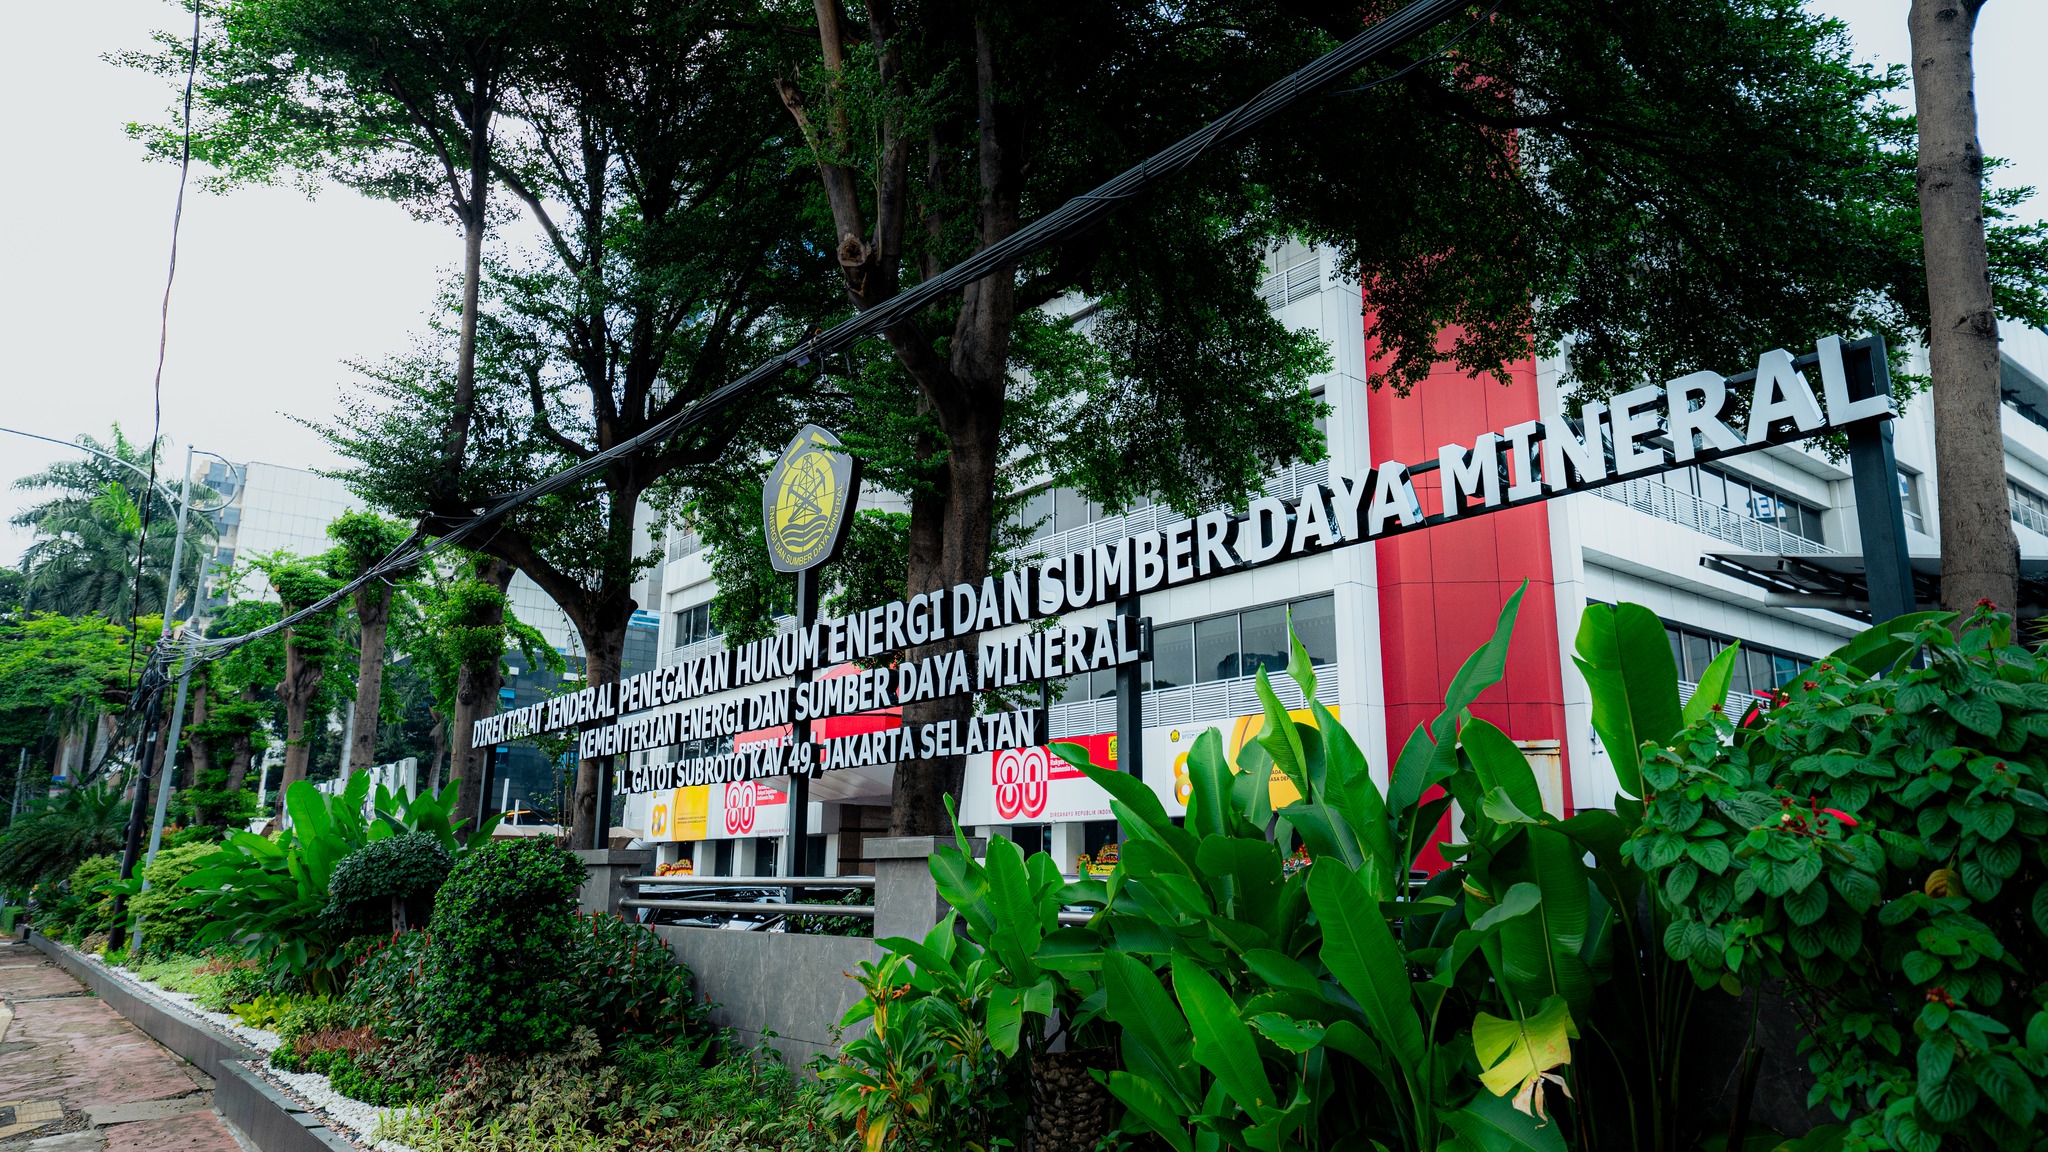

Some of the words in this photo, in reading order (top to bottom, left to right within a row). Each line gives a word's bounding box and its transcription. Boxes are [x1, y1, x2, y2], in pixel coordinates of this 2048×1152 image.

[472, 702, 545, 749] DIREKTORAT
[544, 682, 615, 732] JENDERAL
[619, 651, 729, 711] PENEGAKAN
[735, 624, 820, 685] HUKUM
[830, 588, 945, 664] ENERGI
[952, 566, 1030, 637] DAN
[1038, 509, 1237, 615] SUMBER
[1250, 460, 1424, 564] DAYA
[1439, 335, 1897, 517] MINERAL
[769, 505, 778, 543] ENERGI
[774, 541, 787, 560] DAN
[785, 552, 813, 566] SUMBER
[813, 534, 830, 557] DAYA
[828, 482, 843, 533] MINERAL
[579, 711, 677, 760] KEMENTERIAN
[680, 699, 744, 742] ENERGI
[748, 688, 788, 731] DAN
[795, 667, 891, 721] SUMBER
[898, 650, 970, 704] DAYA
[978, 614, 1139, 691] MINERAL
[614, 769, 631, 796] JL.
[632, 762, 676, 793] GATOT
[676, 751, 746, 788] SUBROTO
[821, 726, 915, 771] JAKARTA
[920, 708, 1036, 760] SELATAN
[996, 746, 1048, 820] 80
[652, 803, 667, 837] 80
[726, 780, 756, 835] 80
